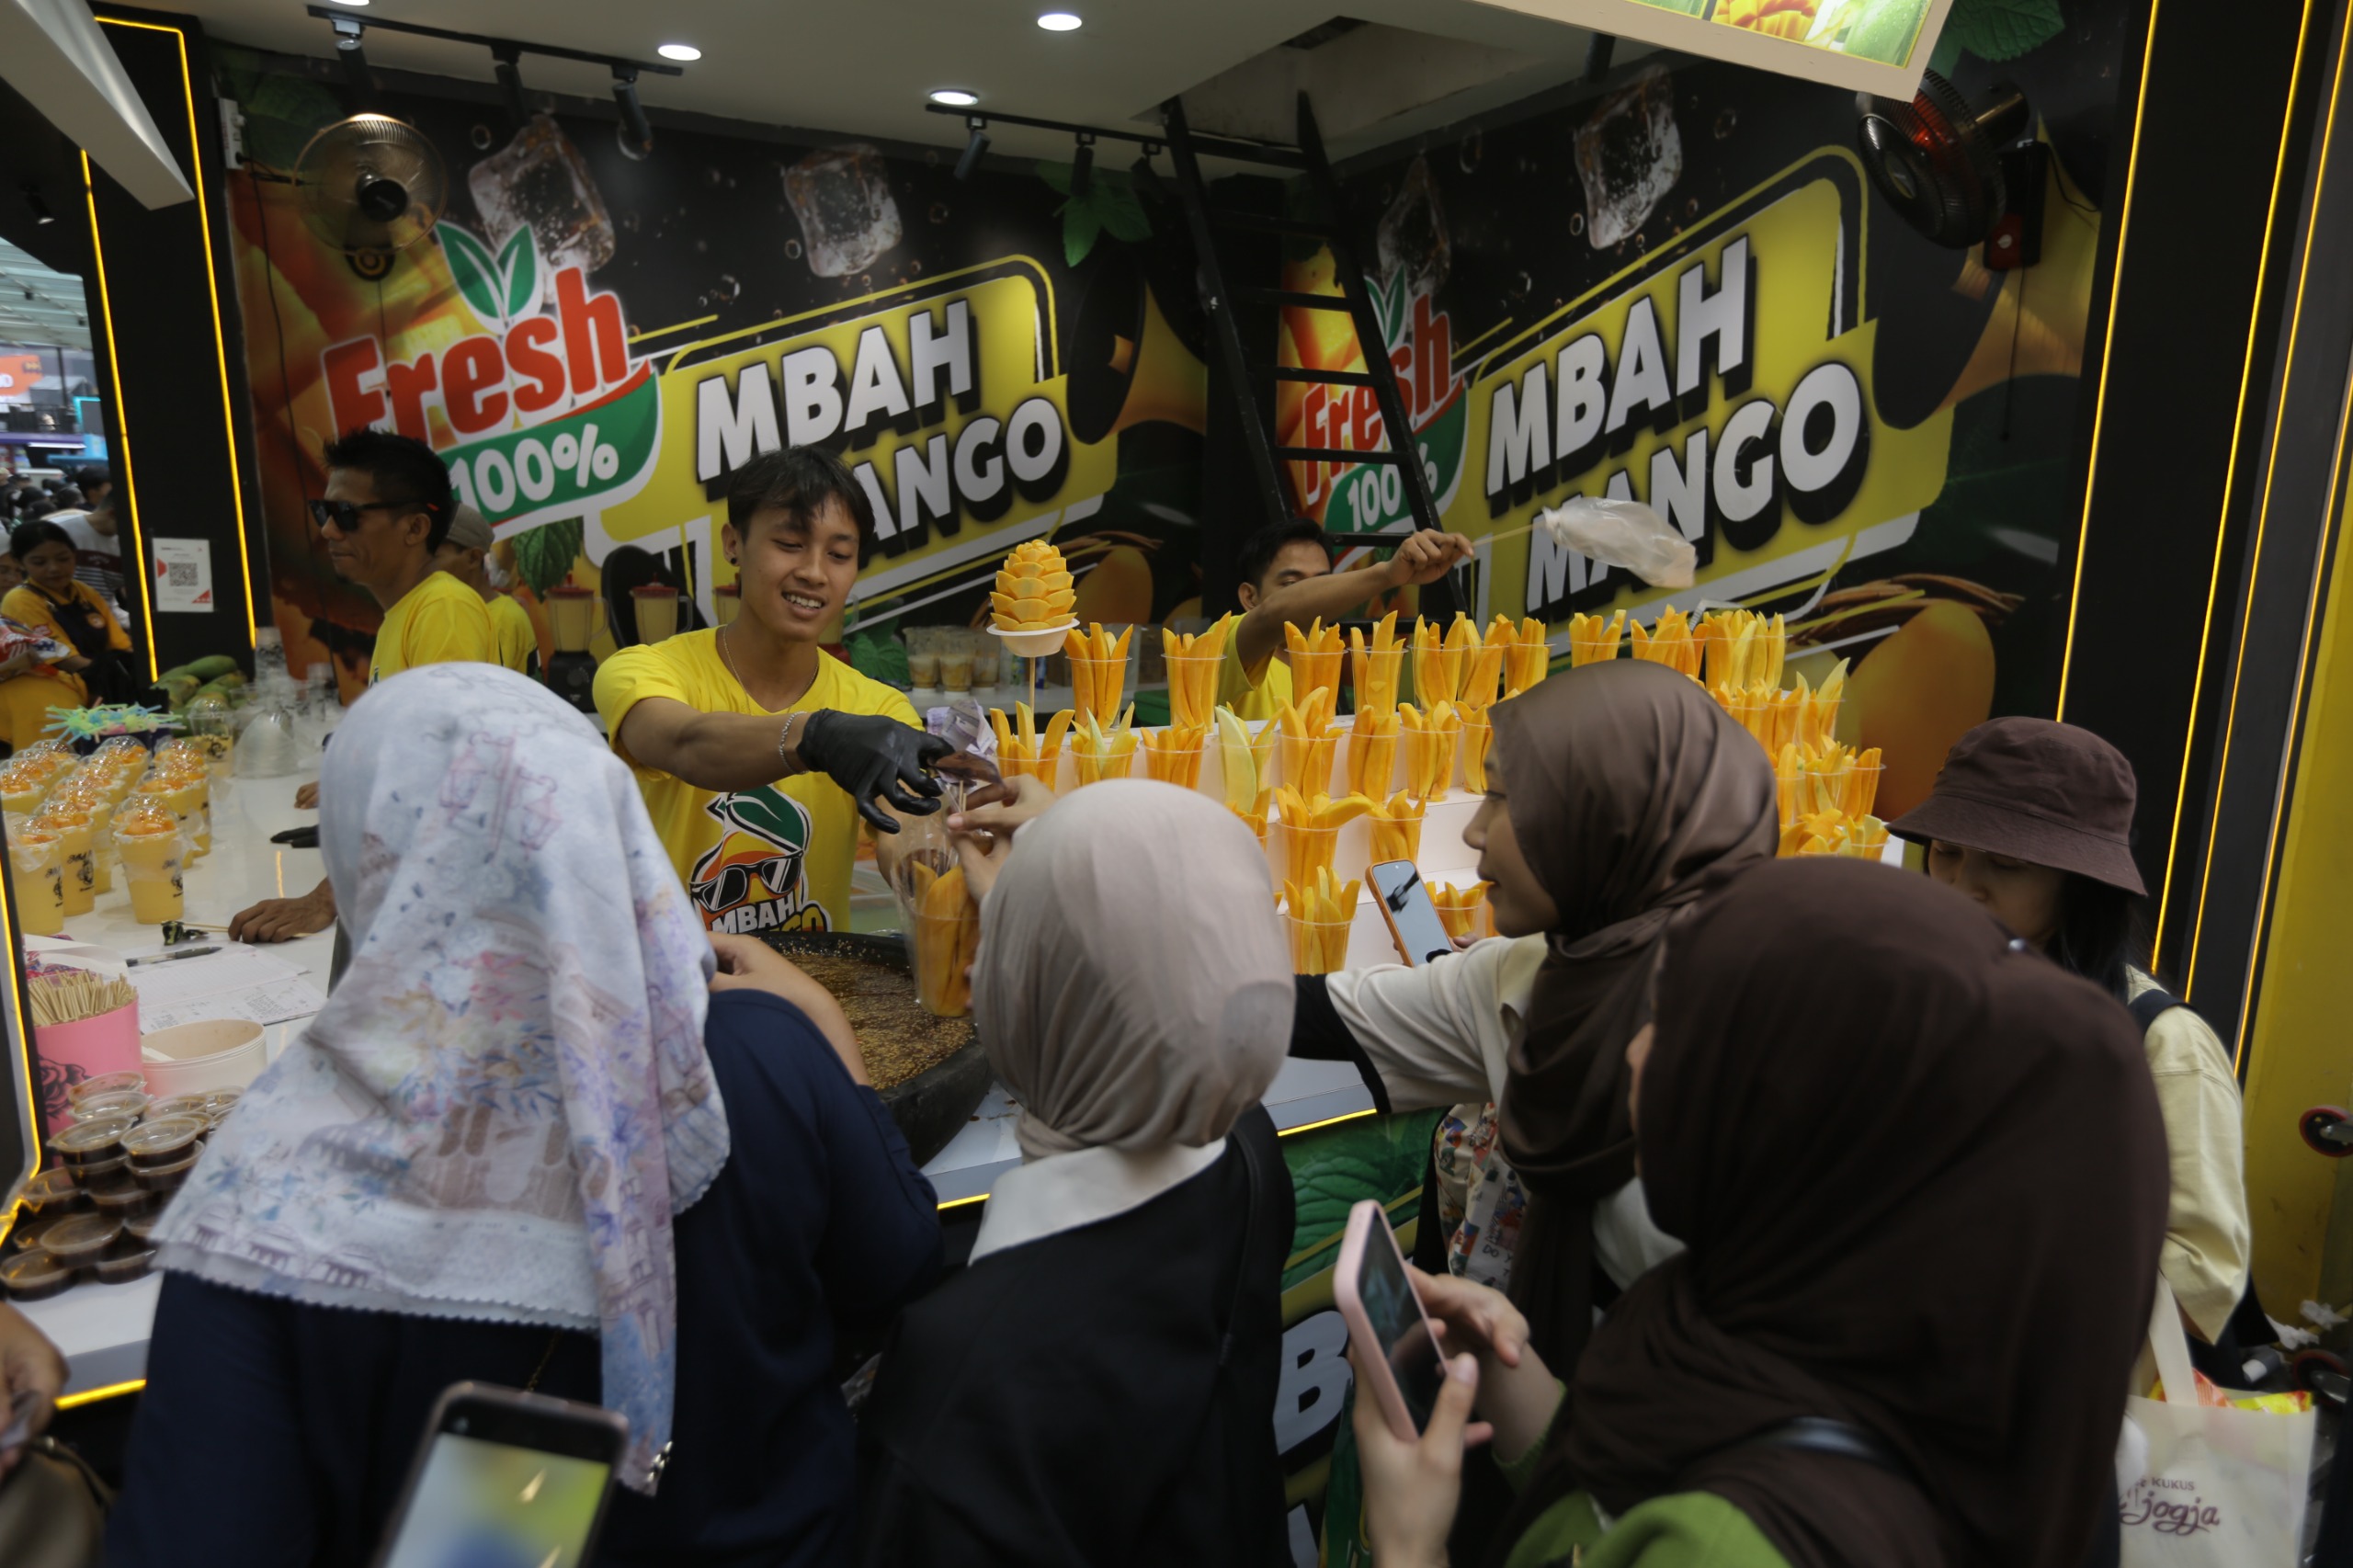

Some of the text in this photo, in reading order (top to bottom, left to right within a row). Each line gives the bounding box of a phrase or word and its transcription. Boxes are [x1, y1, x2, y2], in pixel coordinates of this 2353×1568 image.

[324, 267, 629, 444] Fresh
[697, 300, 972, 482] MBAH
[1486, 236, 1750, 497] MBAH
[449, 423, 620, 513] 100%
[853, 398, 1063, 541] NGO
[711, 889, 795, 934] MBAH
[2152, 1477, 2196, 1491] KUKUS
